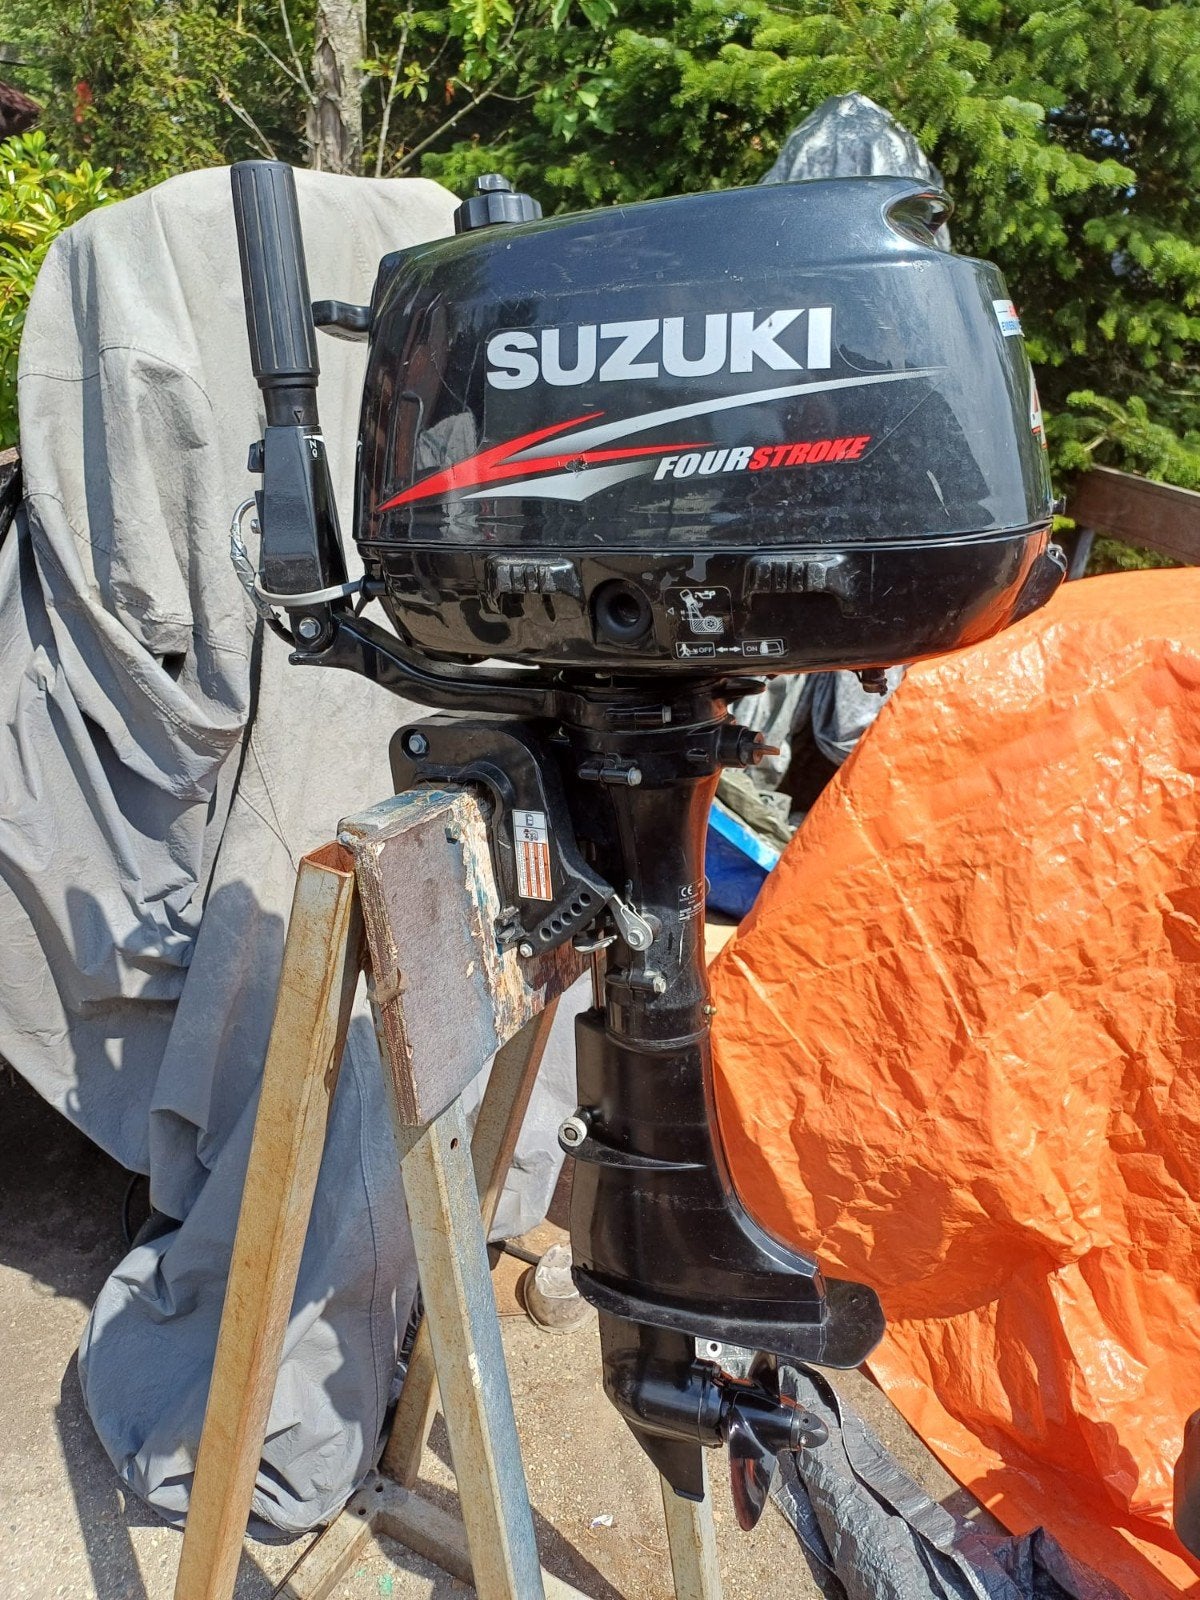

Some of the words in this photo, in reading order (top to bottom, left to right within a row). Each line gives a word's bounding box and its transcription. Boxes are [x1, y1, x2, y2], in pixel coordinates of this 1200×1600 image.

[486, 307, 833, 390] SUZUKI
[699, 646, 713, 654] OFF
[680, 885, 693, 898] CE
